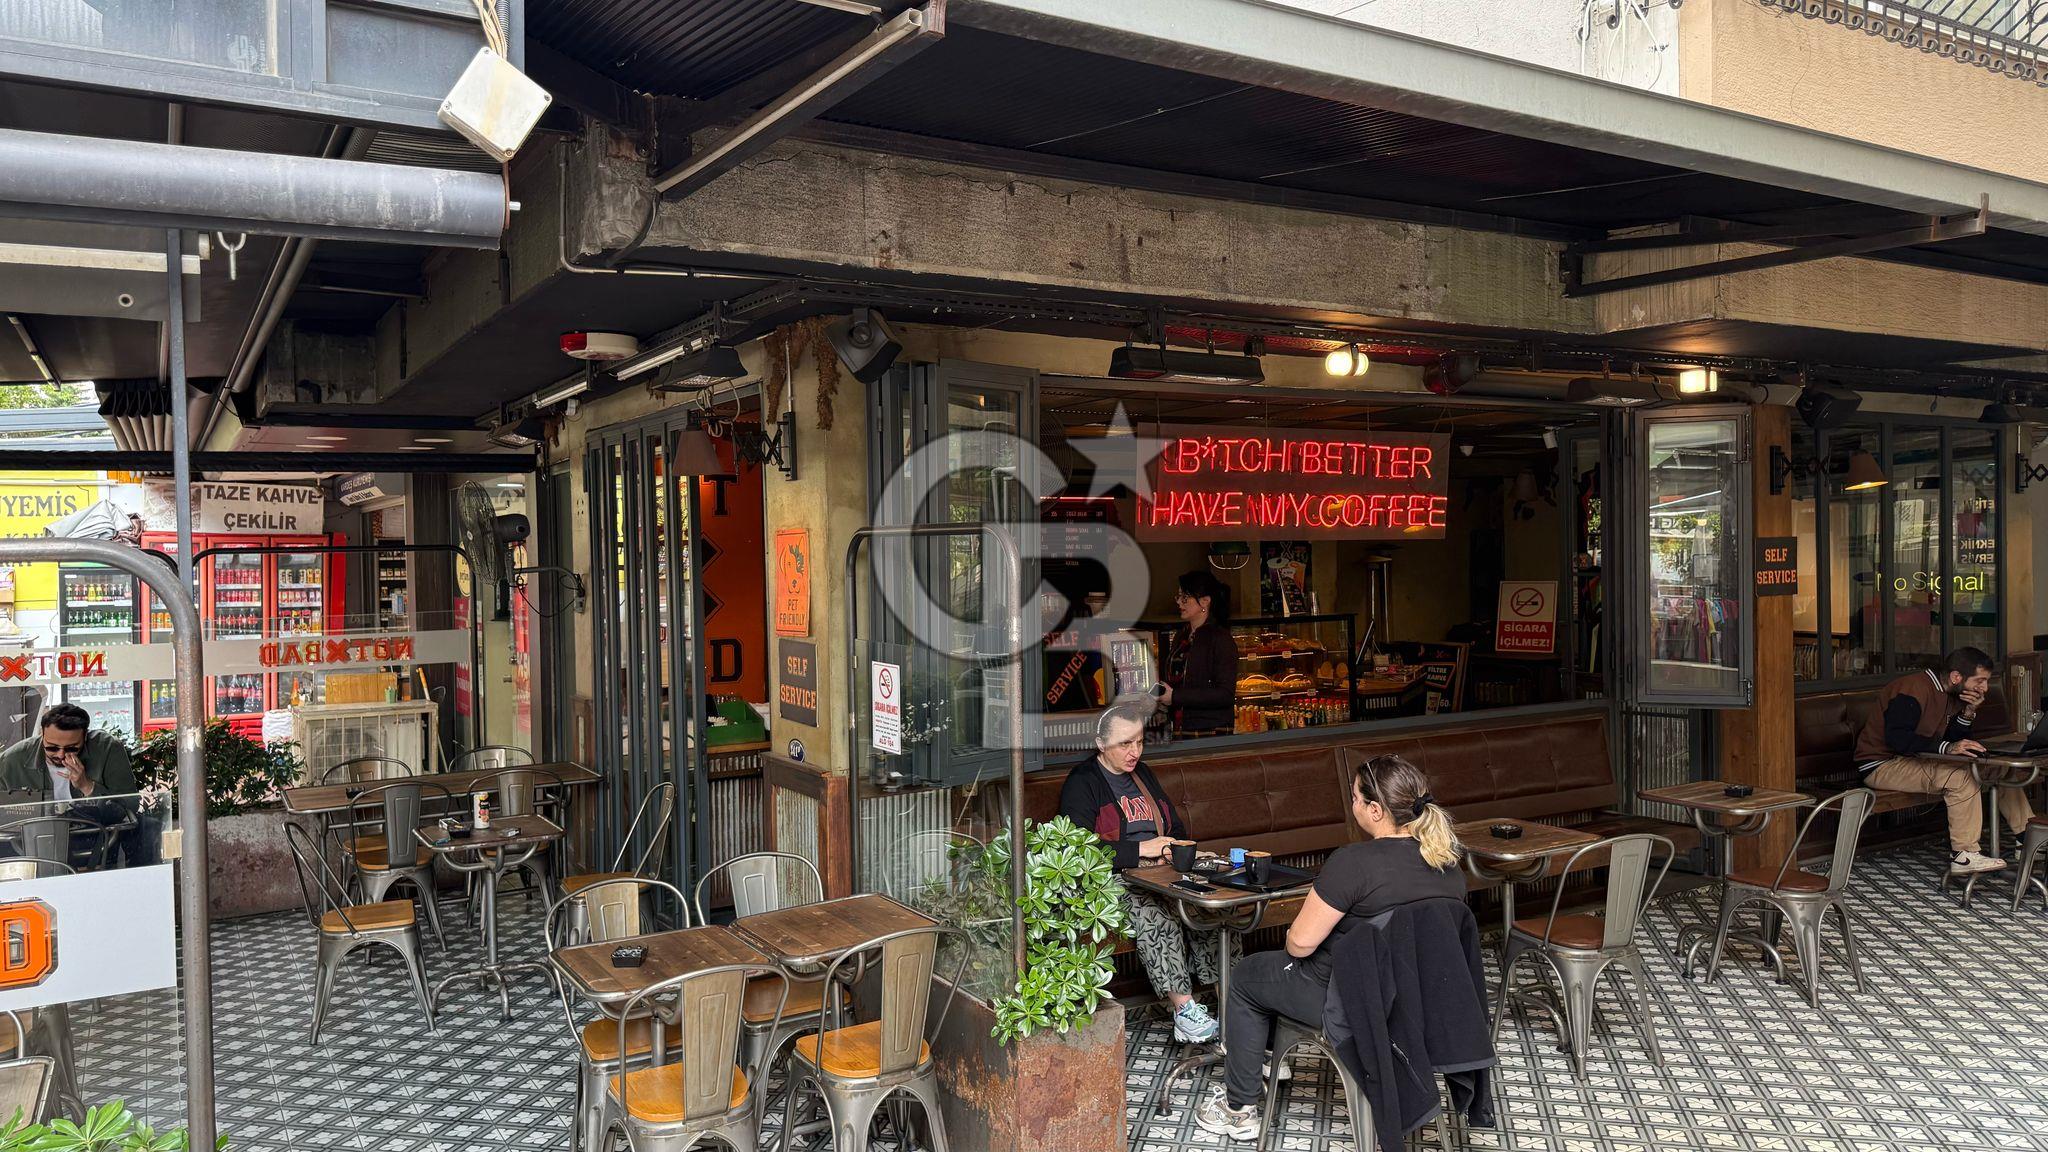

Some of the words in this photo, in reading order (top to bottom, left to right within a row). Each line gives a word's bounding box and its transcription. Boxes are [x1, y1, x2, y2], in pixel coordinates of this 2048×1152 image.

[1302, 441, 1432, 479] BETTER
[203, 484, 251, 501] TAZE
[256, 486, 319, 505] KAHVE
[1151, 491, 1243, 527] HAVE
[1261, 492, 1309, 527] MY
[1319, 493, 1448, 528] COFFEE
[223, 511, 298, 532] ÇEKİLİR
[1764, 548, 1788, 562] SELF
[1756, 570, 1797, 584] SERVICE
[787, 599, 799, 611] PET
[779, 613, 807, 626] FRIENDLY
[1503, 622, 1548, 633] SİGARA
[1042, 631, 1079, 647] SELF
[1500, 635, 1550, 648] İÇİLMEZ!
[787, 655, 808, 677] SELF
[1046, 650, 1088, 705] SERVICE
[780, 683, 817, 709] SERVICE
